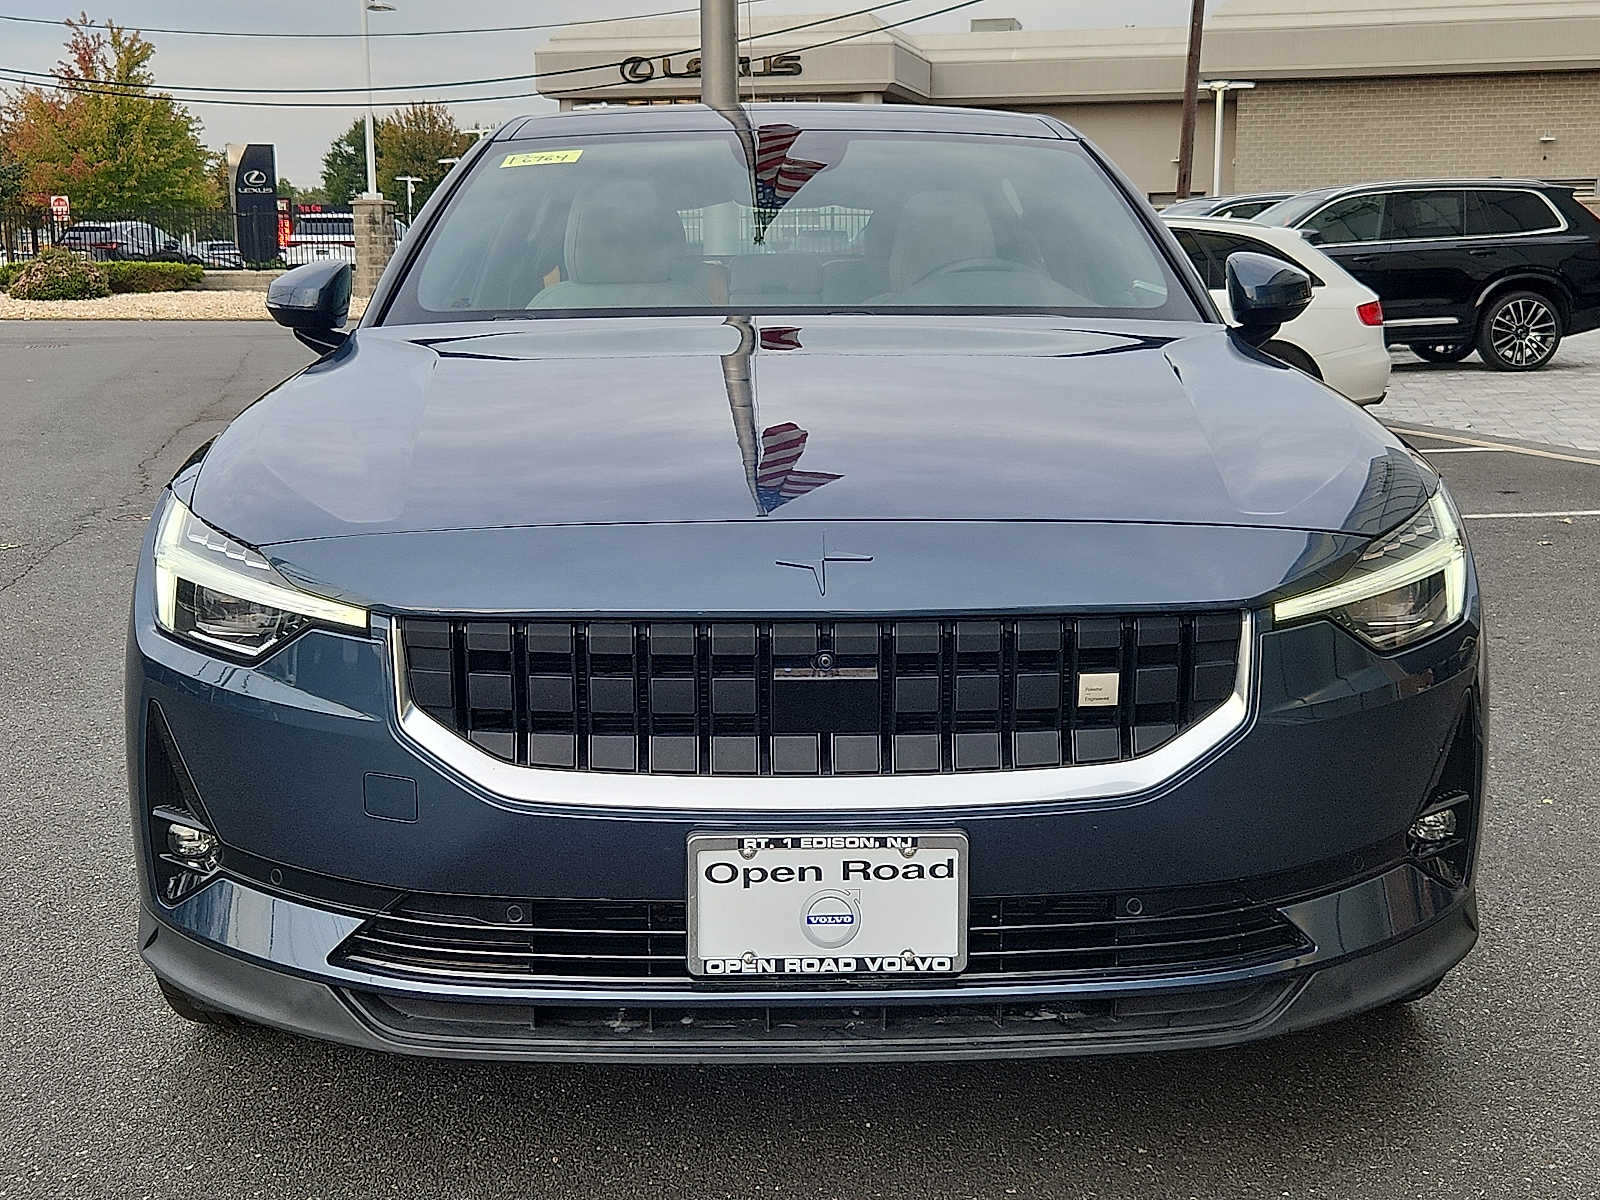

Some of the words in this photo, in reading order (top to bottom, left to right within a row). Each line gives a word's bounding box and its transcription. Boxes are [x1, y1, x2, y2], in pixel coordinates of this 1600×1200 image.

[743, 837, 774, 849] RT.
[782, 837, 792, 848] 1
[886, 837, 913, 848] NJ
[704, 862, 823, 889] Open
[842, 858, 955, 881] Road
[808, 916, 853, 924] VOLVO
[705, 957, 776, 974] OPEN
[784, 957, 856, 973] ROAD
[864, 956, 951, 971] VOLVO
